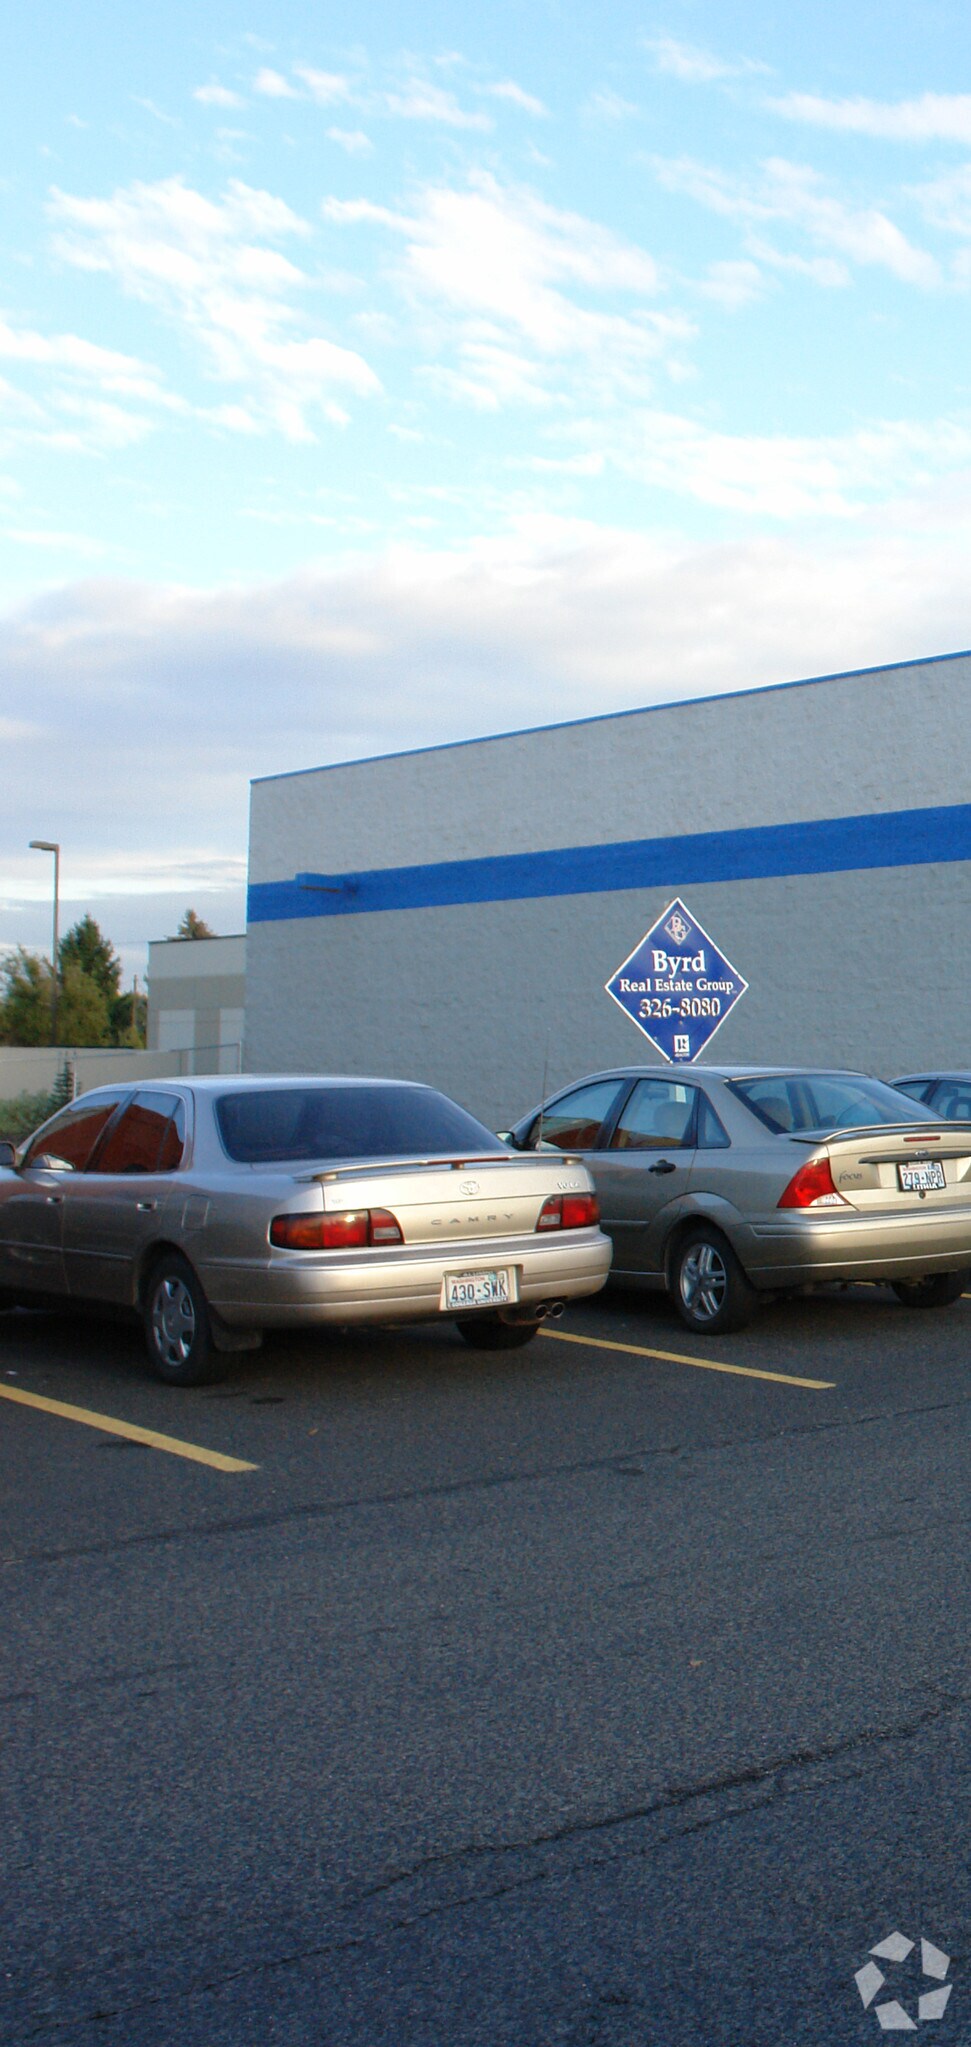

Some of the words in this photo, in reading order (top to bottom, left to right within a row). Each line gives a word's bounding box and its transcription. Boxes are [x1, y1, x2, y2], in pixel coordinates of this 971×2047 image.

[652, 950, 706, 978] Byrd
[619, 979, 651, 992] Real
[655, 978, 693, 992] Estate
[696, 977, 734, 995] Group
[638, 997, 721, 1018] 326-8080
[430, 1213, 514, 1226] CAMRY
